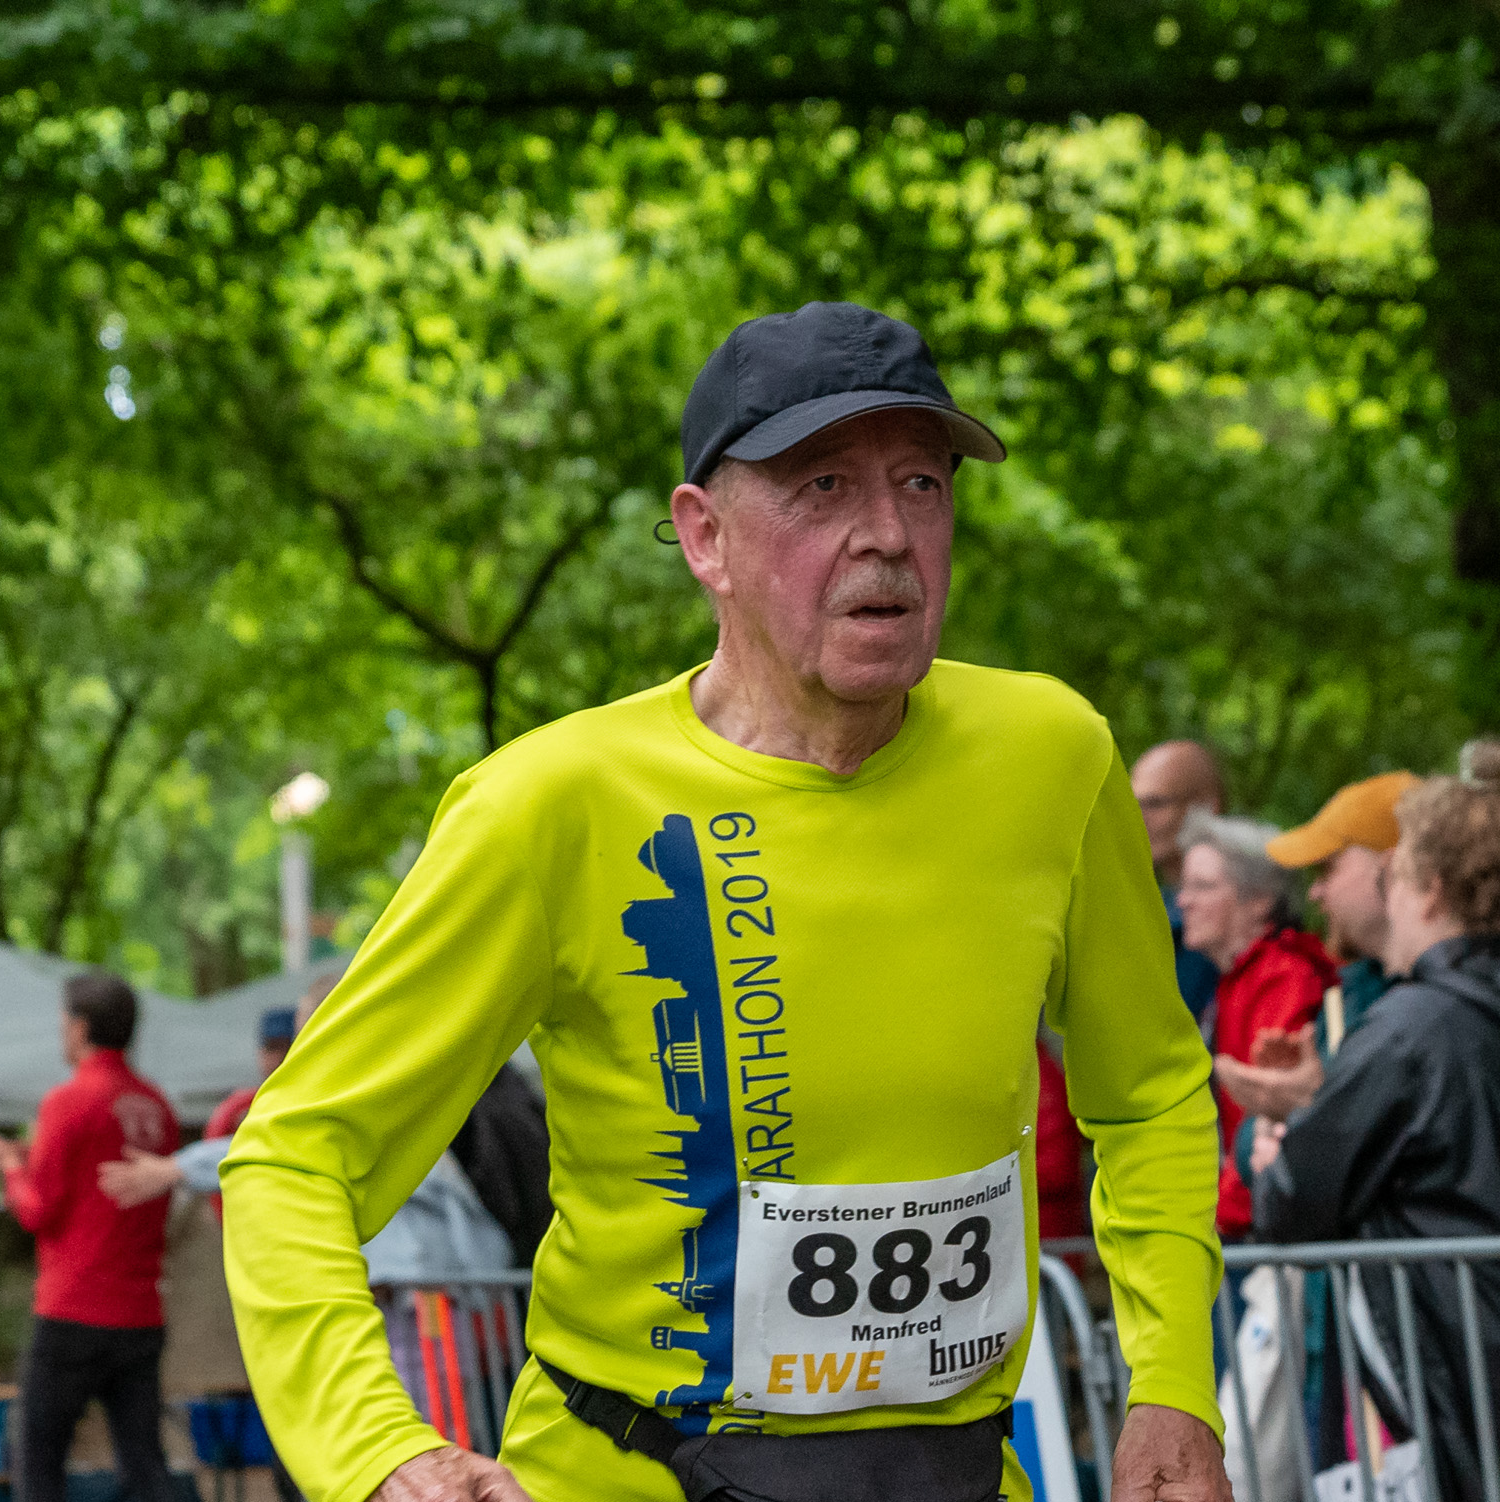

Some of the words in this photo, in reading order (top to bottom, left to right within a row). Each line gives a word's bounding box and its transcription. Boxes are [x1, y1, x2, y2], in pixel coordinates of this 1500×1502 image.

[708, 811, 776, 938] 2019
[729, 954, 796, 1181] ARATHON
[762, 1202, 896, 1222] Everstener
[902, 1175, 1013, 1219] Brunnenlauf
[787, 1215, 992, 1318] 883
[766, 1350, 886, 1395] EWE
[929, 1331, 1007, 1377] bruns
[851, 1315, 942, 1342] Manfred
